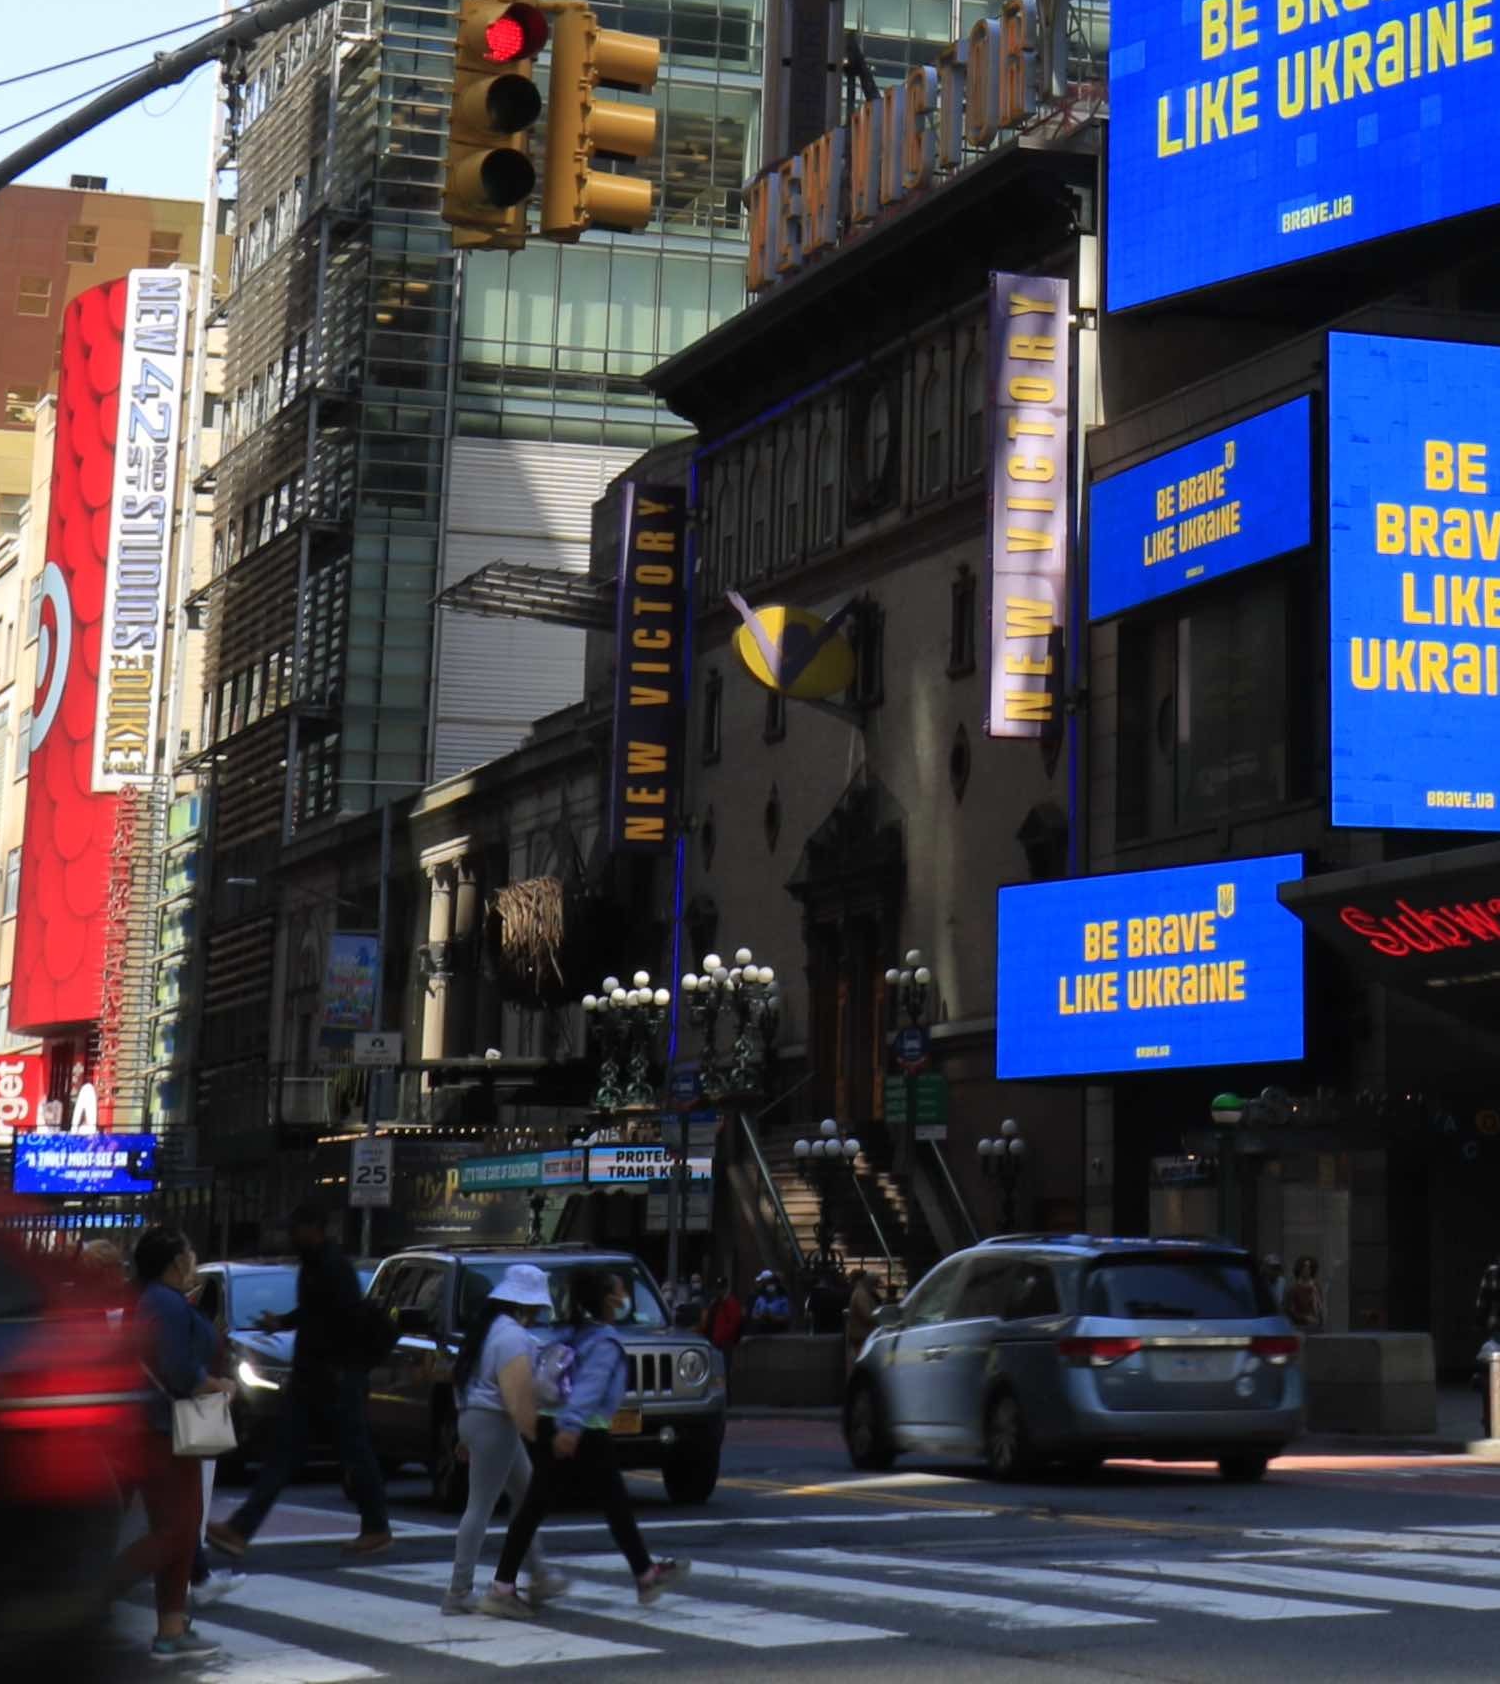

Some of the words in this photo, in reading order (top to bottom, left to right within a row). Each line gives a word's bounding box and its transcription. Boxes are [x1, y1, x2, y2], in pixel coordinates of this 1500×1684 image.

[1157, 66, 1259, 159] LIKE
[746, 126, 846, 293] NEW
[134, 277, 182, 356] NEW
[1007, 291, 1059, 555] VICTORY
[1155, 485, 1176, 522] BE
[1424, 439, 1489, 495] BE
[112, 494, 167, 650] STUDIOS
[1142, 525, 1176, 567] LIKE
[629, 497, 676, 707] VICTORY
[1004, 596, 1056, 723] NEW
[104, 669, 154, 759] DUKE
[624, 740, 668, 841] NEW
[1083, 920, 1120, 963] BE
[1057, 971, 1120, 1016] LIKE
[356, 1166, 387, 1185] 25
[616, 1150, 673, 1165] PROTEC
